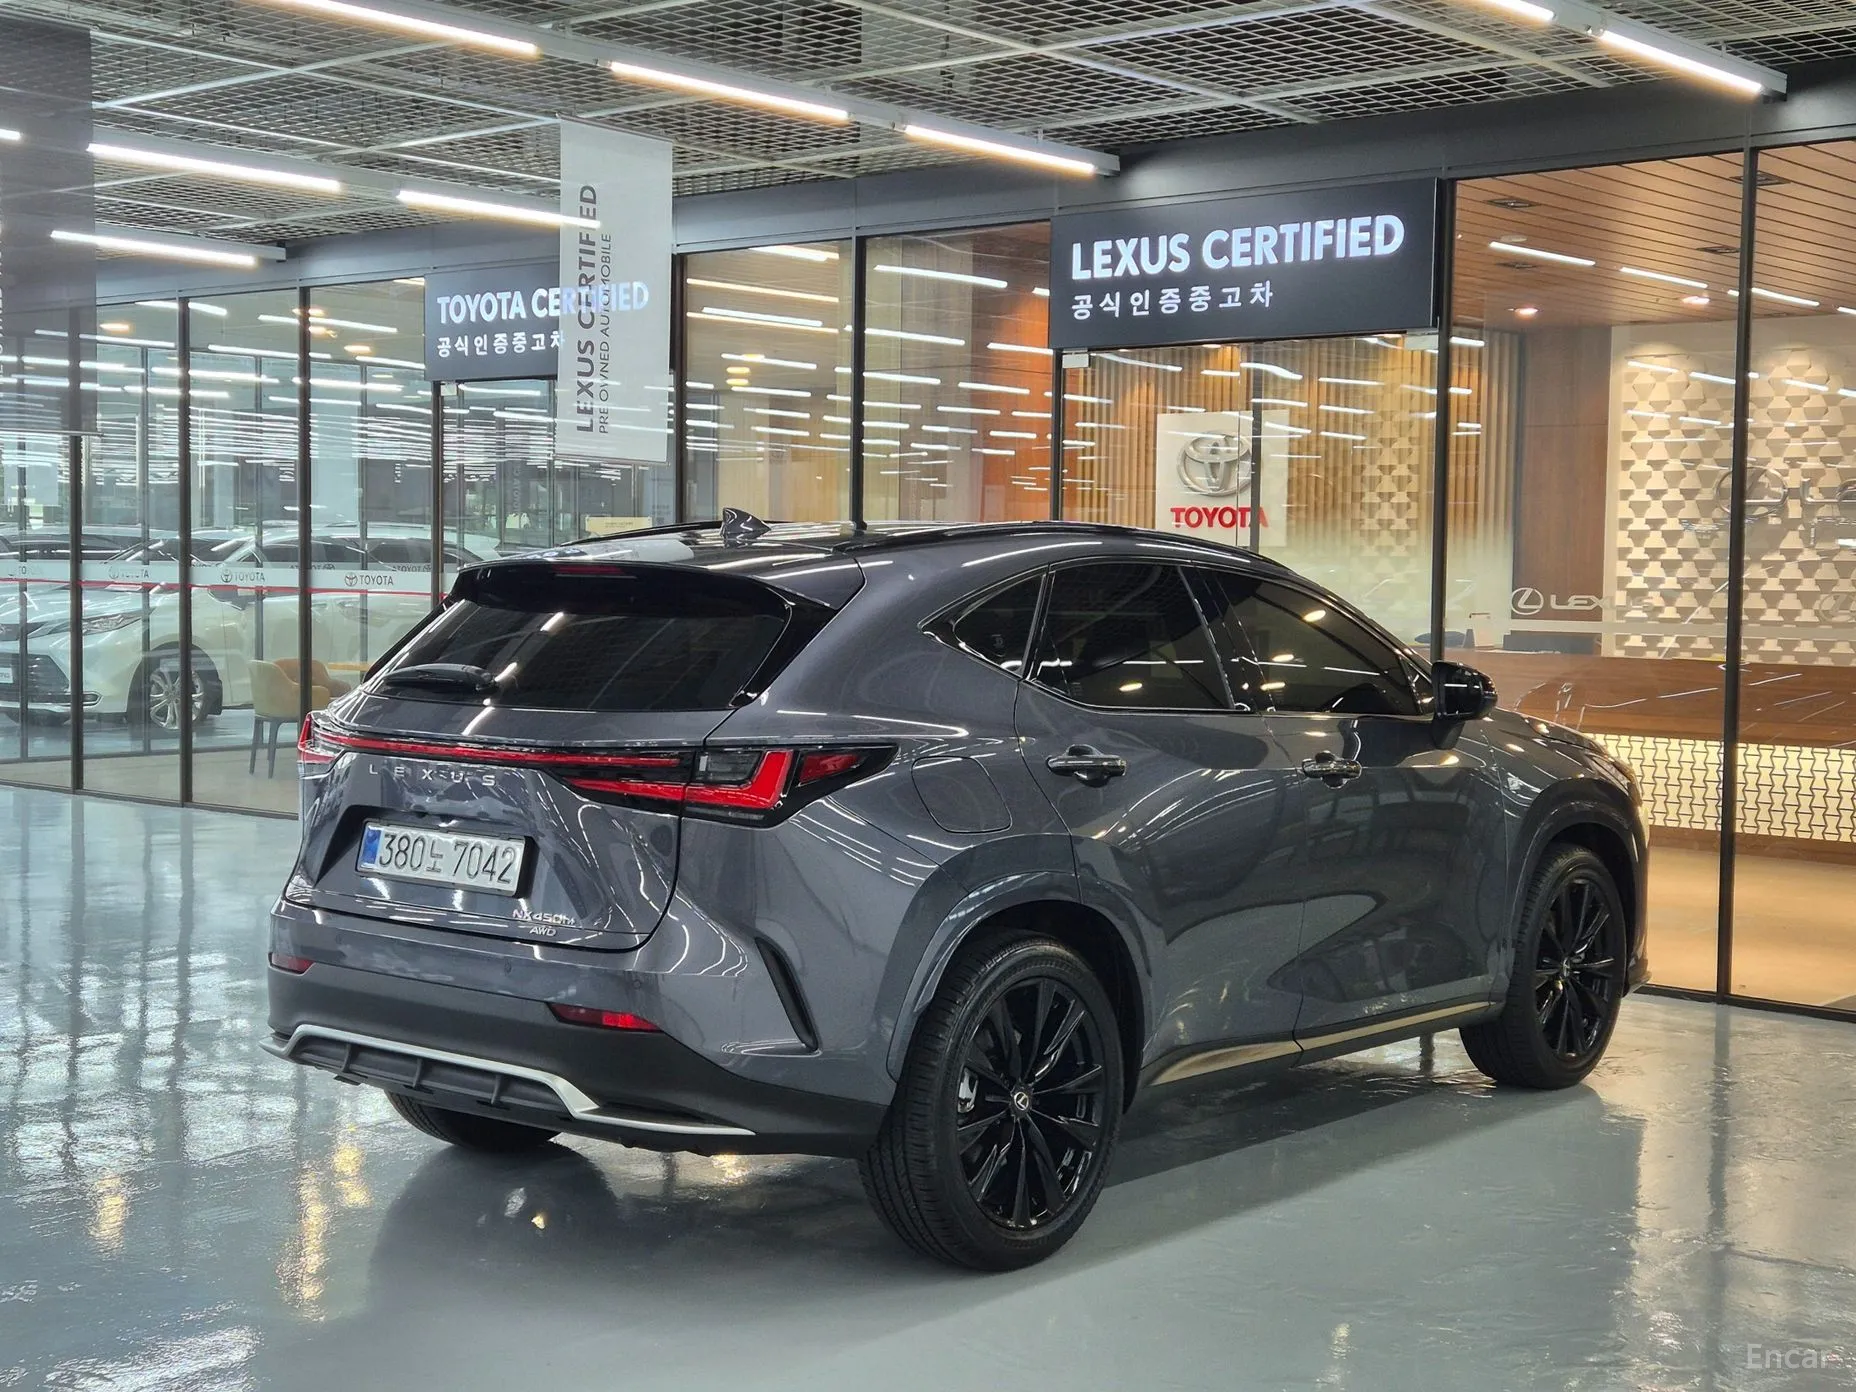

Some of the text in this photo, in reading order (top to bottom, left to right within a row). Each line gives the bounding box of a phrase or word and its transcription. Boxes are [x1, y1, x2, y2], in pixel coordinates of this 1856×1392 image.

[1071, 214, 1405, 280] LEXUS CERTIFIED
[437, 281, 649, 324] TOYOTA CERTIFIED
[1071, 280, 1273, 320] 공식인증중고차
[437, 330, 565, 357] 공식인증중고차
[577, 339, 595, 432] LEXUS
[599, 341, 610, 402] OWNED
[599, 408, 609, 434] PRE
[234, 572, 265, 582] TOYOTA
[360, 574, 394, 586] TOYOTA
[369, 763, 496, 786] LEXUS
[379, 832, 517, 884] 380노 7042
[529, 926, 557, 937] AWD
